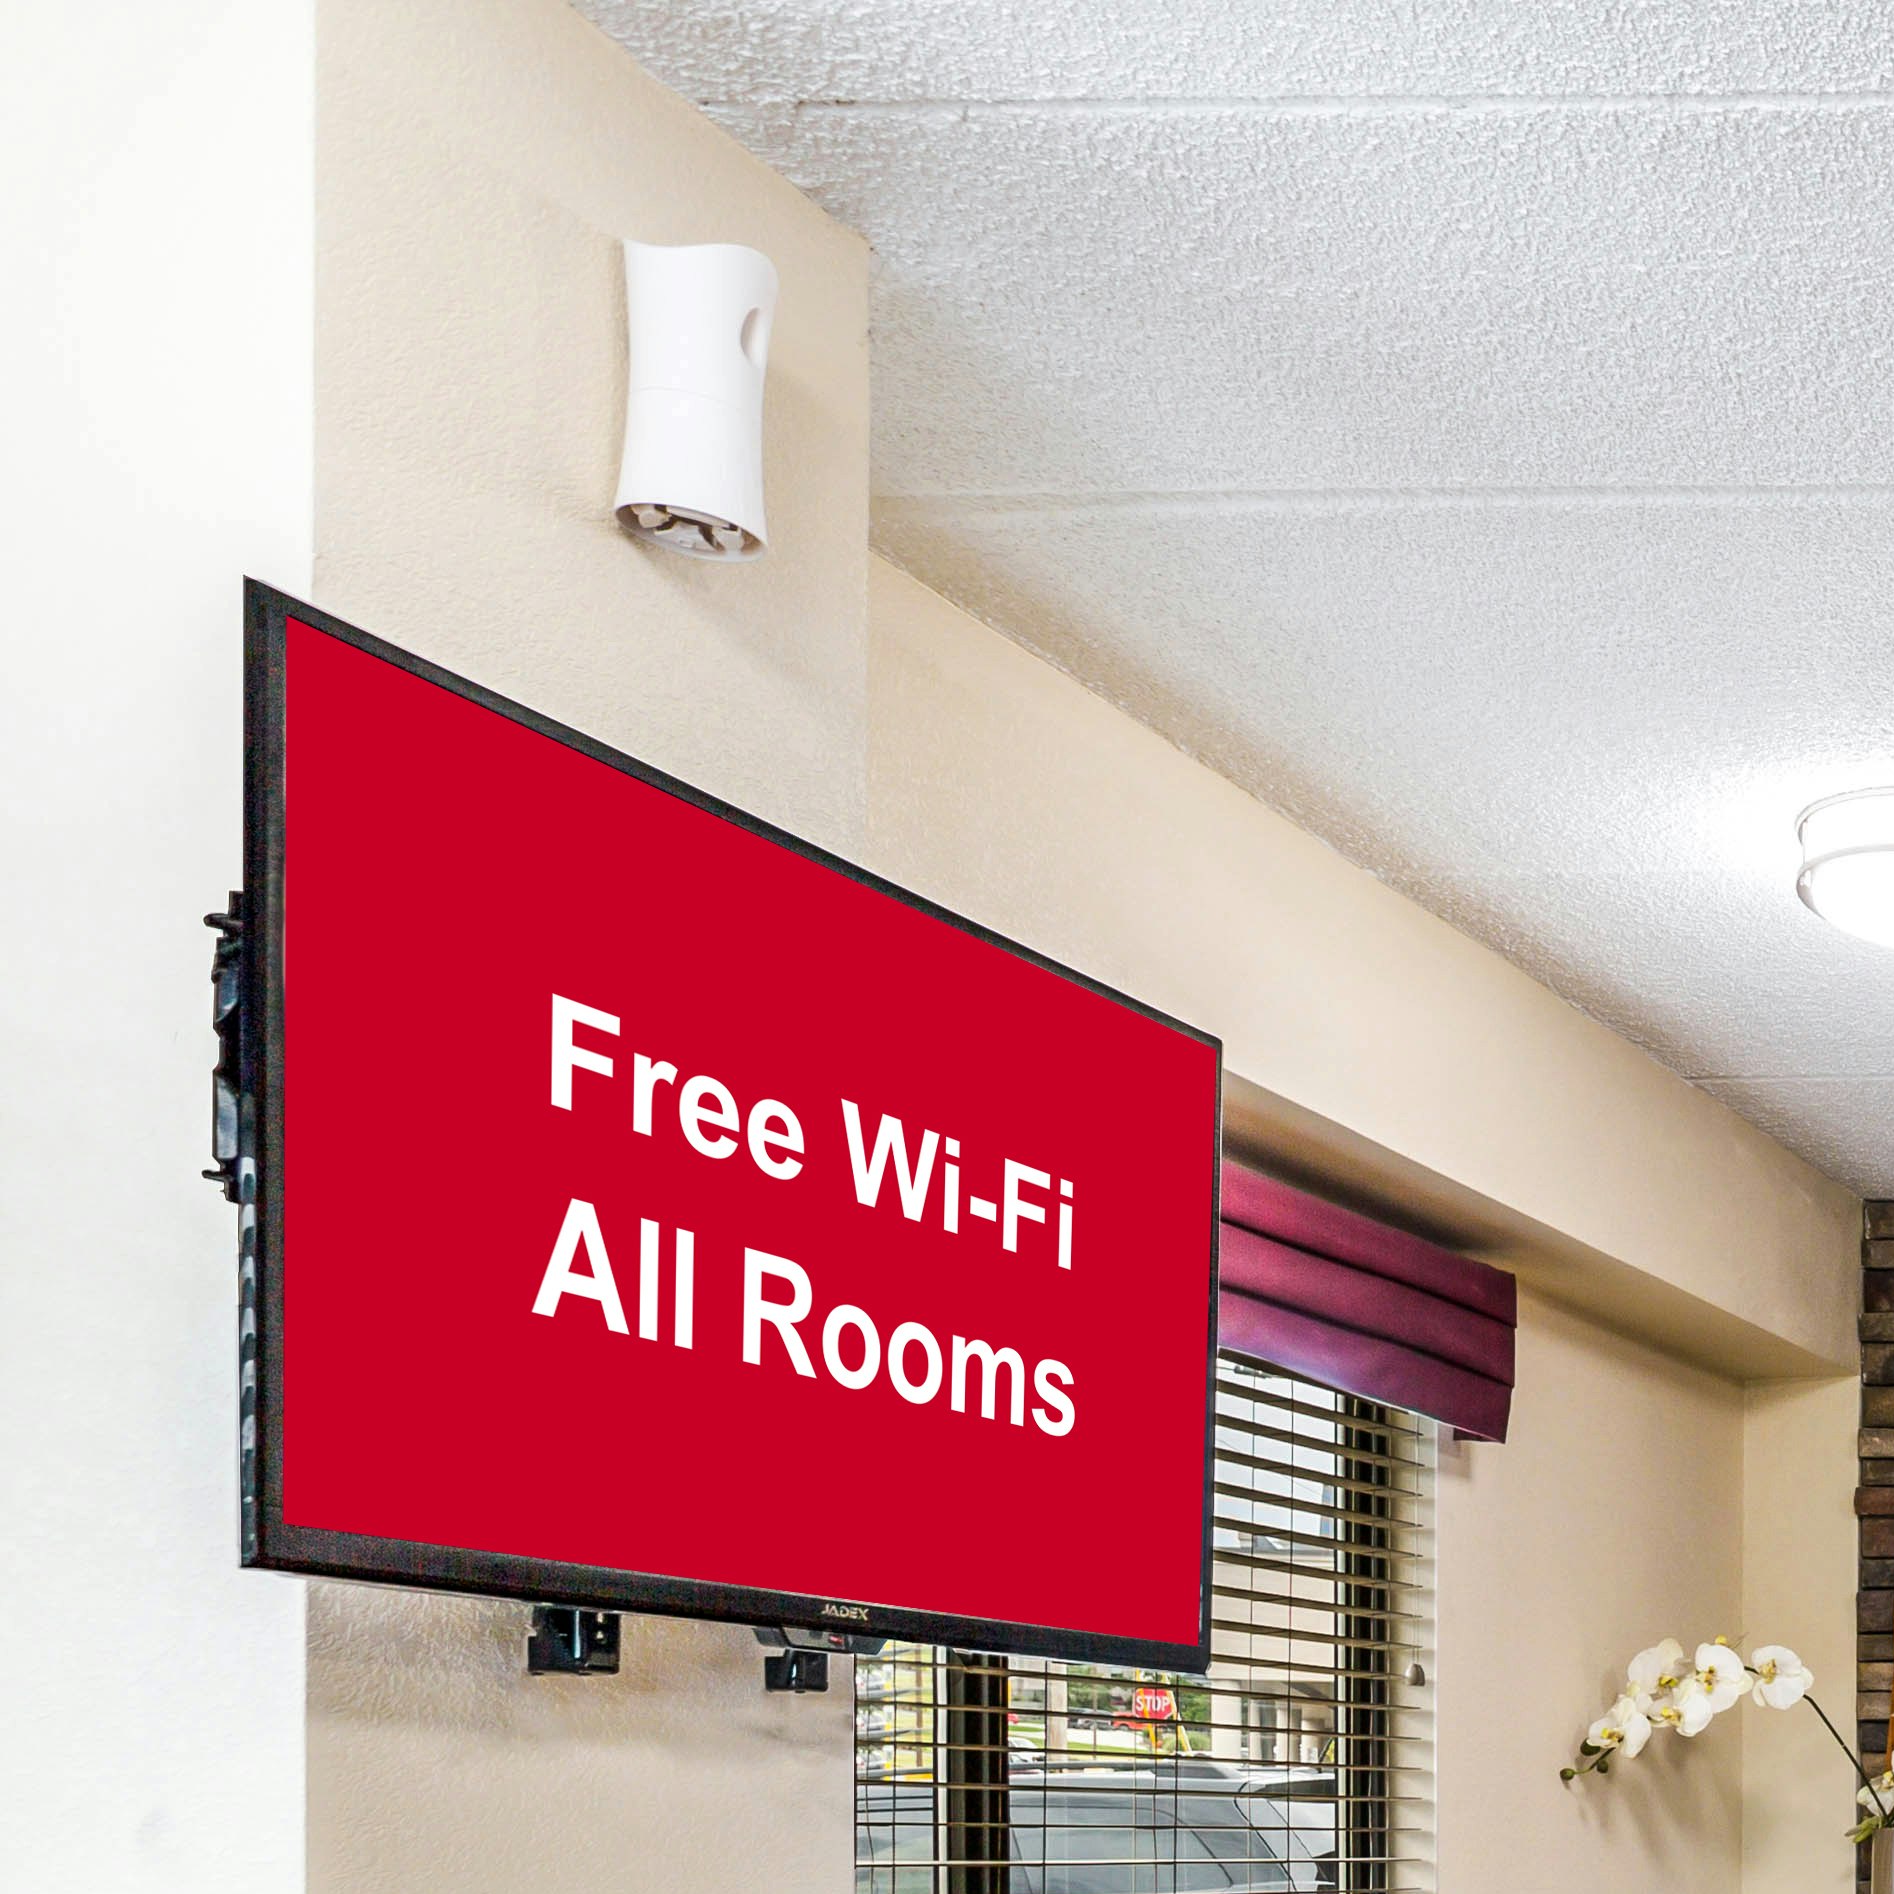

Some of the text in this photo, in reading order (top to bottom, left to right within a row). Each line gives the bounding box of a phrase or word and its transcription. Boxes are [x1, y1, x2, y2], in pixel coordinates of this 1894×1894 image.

[549, 991, 1075, 1272] Free Wi-Fi
[530, 1196, 1077, 1438] All Rooms
[821, 1603, 870, 1621] JADEX
[1135, 1695, 1171, 1712] STOP
